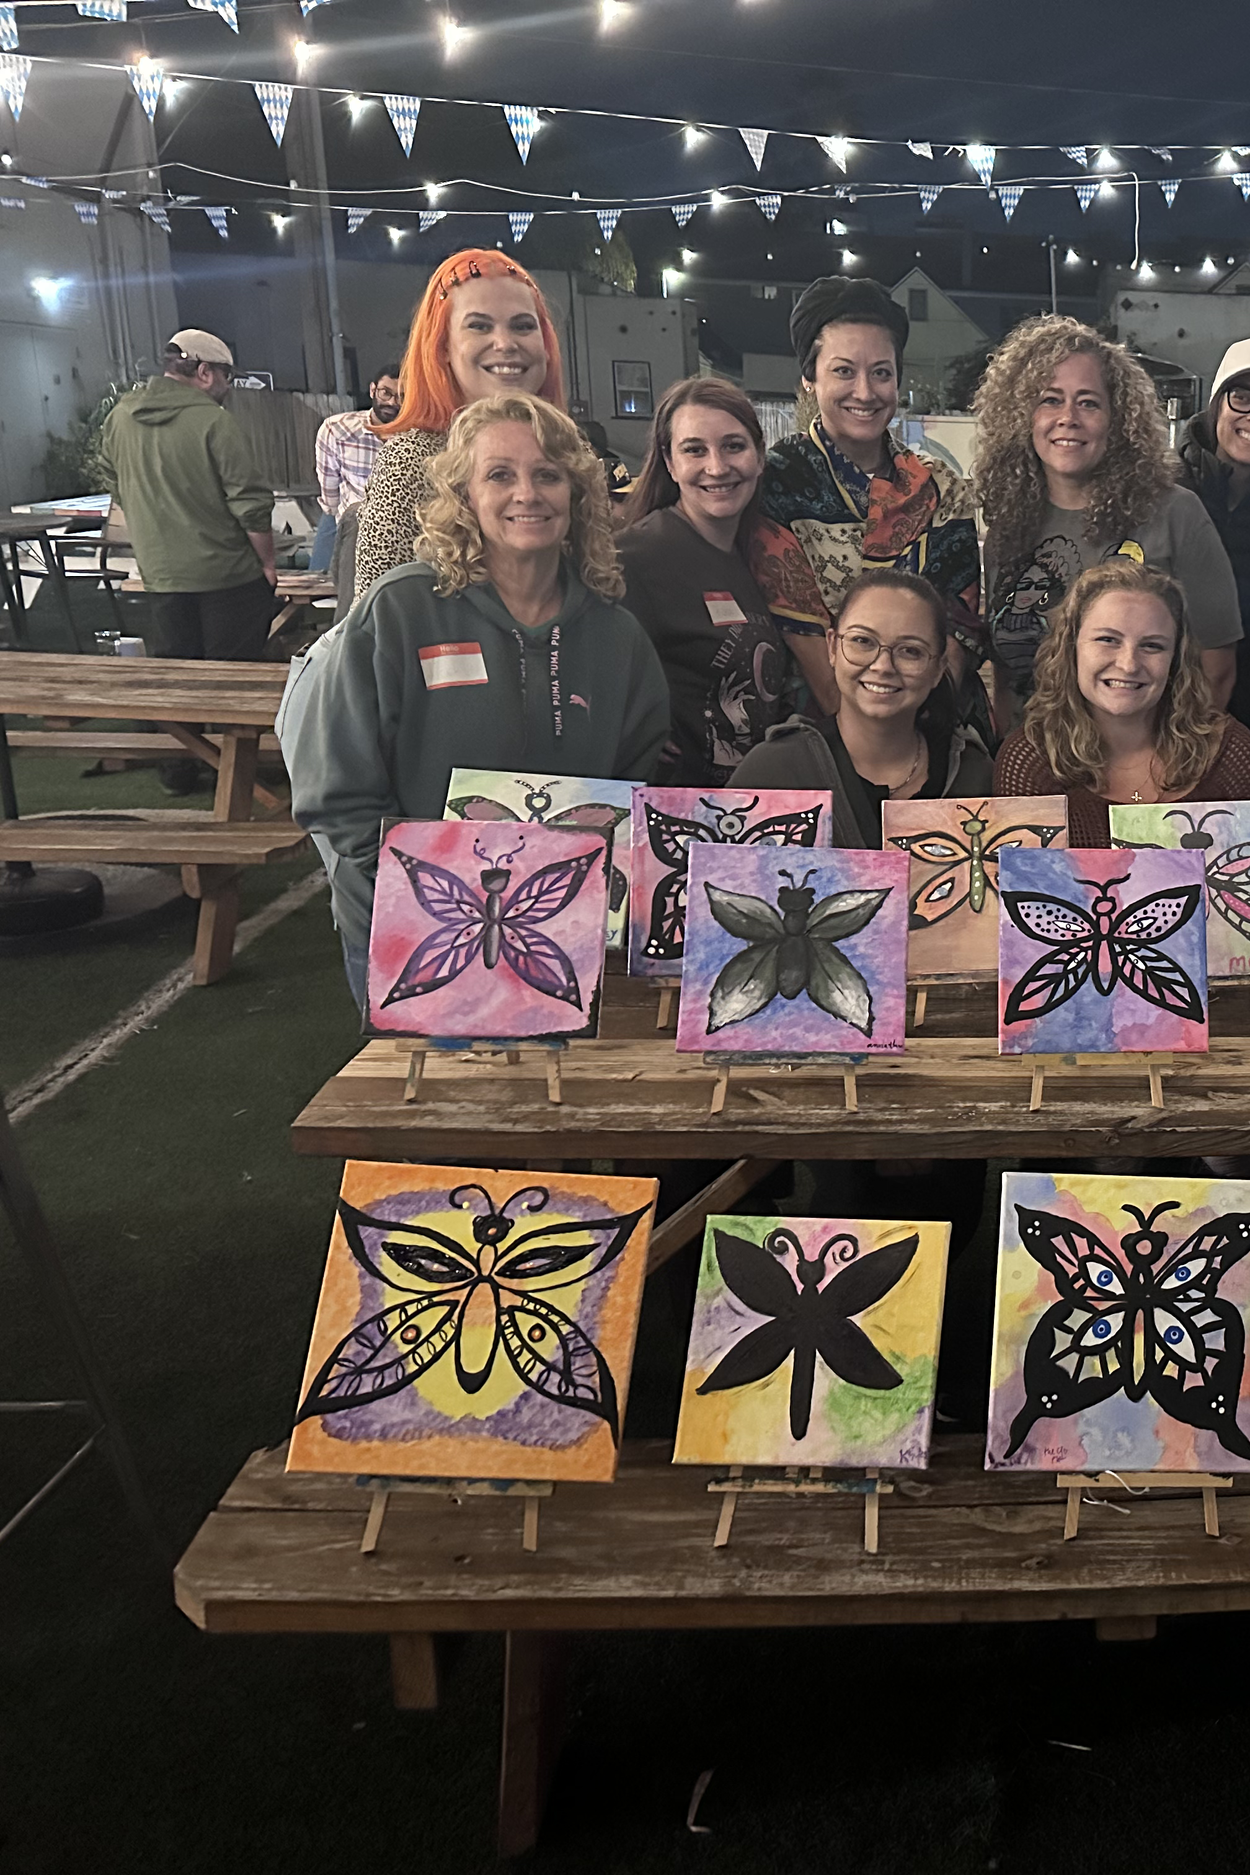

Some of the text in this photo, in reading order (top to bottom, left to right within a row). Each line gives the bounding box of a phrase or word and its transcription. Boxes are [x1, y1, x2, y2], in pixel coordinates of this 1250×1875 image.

[550, 650, 559, 676] PUMA
[710, 639, 736, 668] THEY
[551, 680, 560, 706] PUMA
